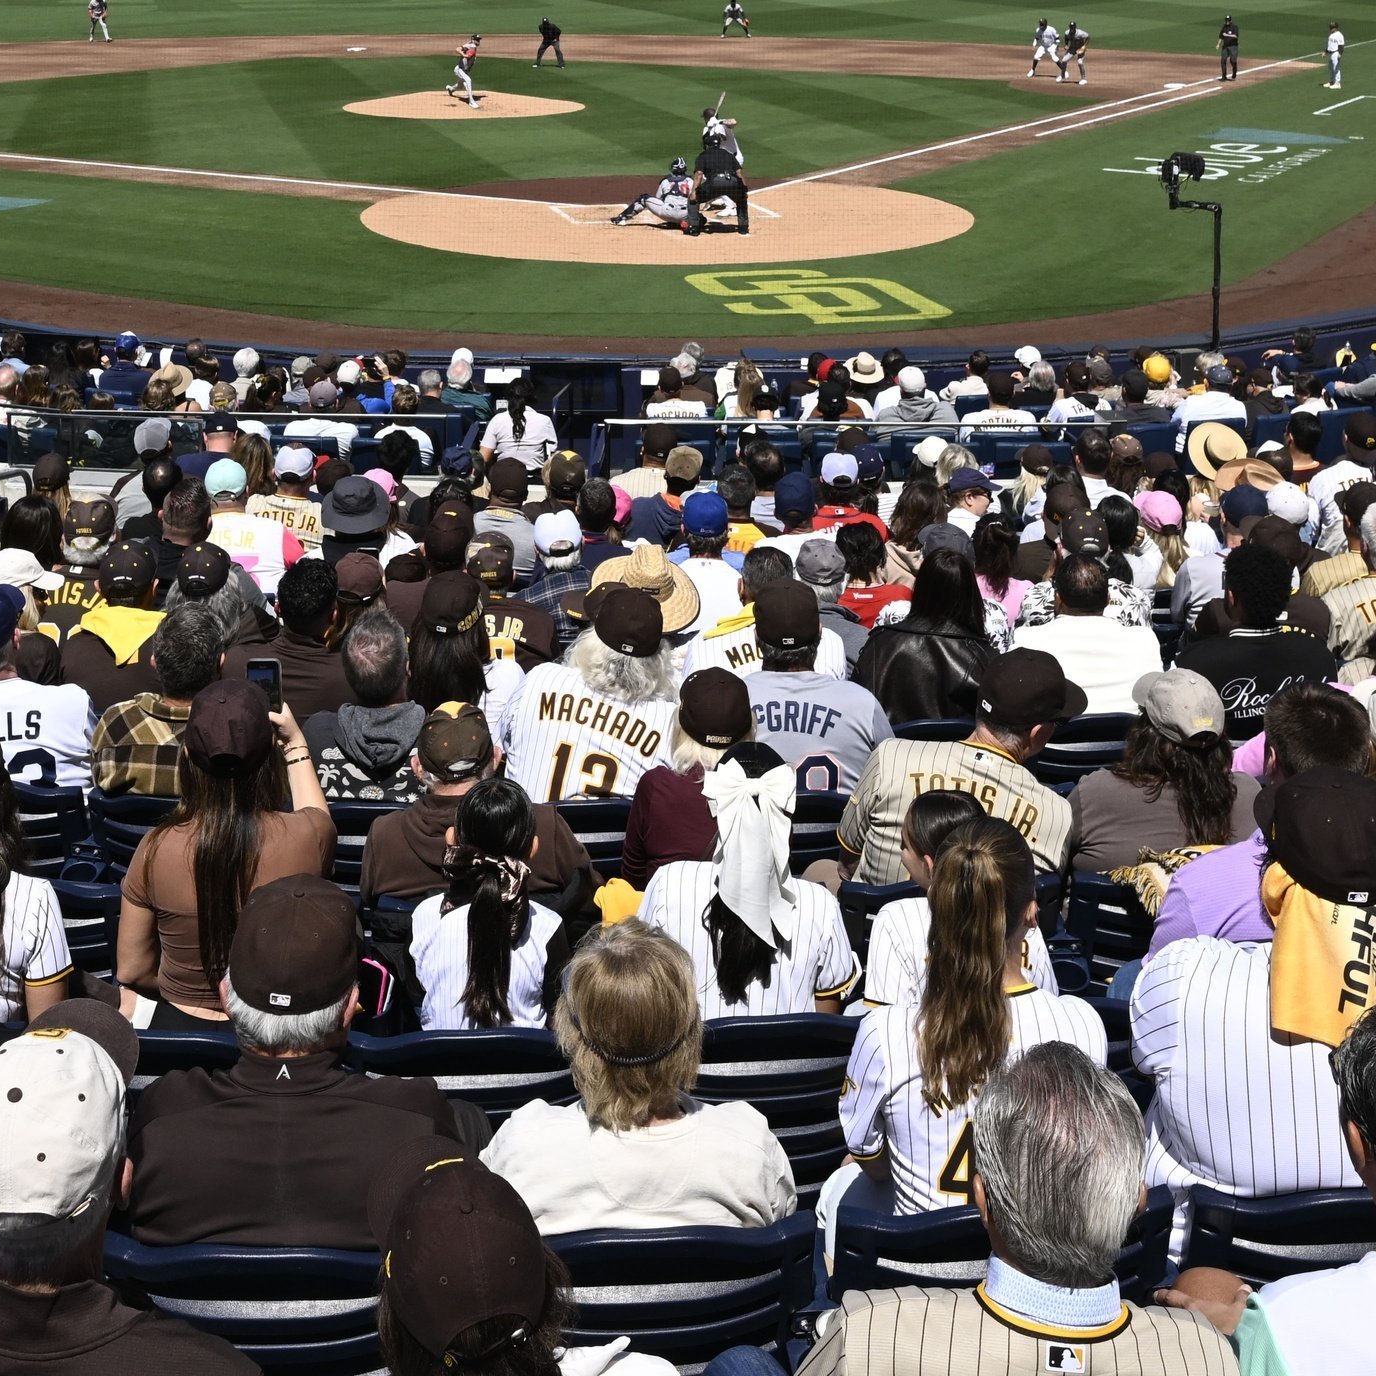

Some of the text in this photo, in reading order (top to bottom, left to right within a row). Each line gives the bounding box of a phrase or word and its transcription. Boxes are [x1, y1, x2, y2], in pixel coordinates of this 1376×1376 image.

[298, 514, 319, 535] JR.
[497, 614, 527, 644] JR.
[538, 692, 662, 759] MACHADO
[548, 740, 620, 801] 13
